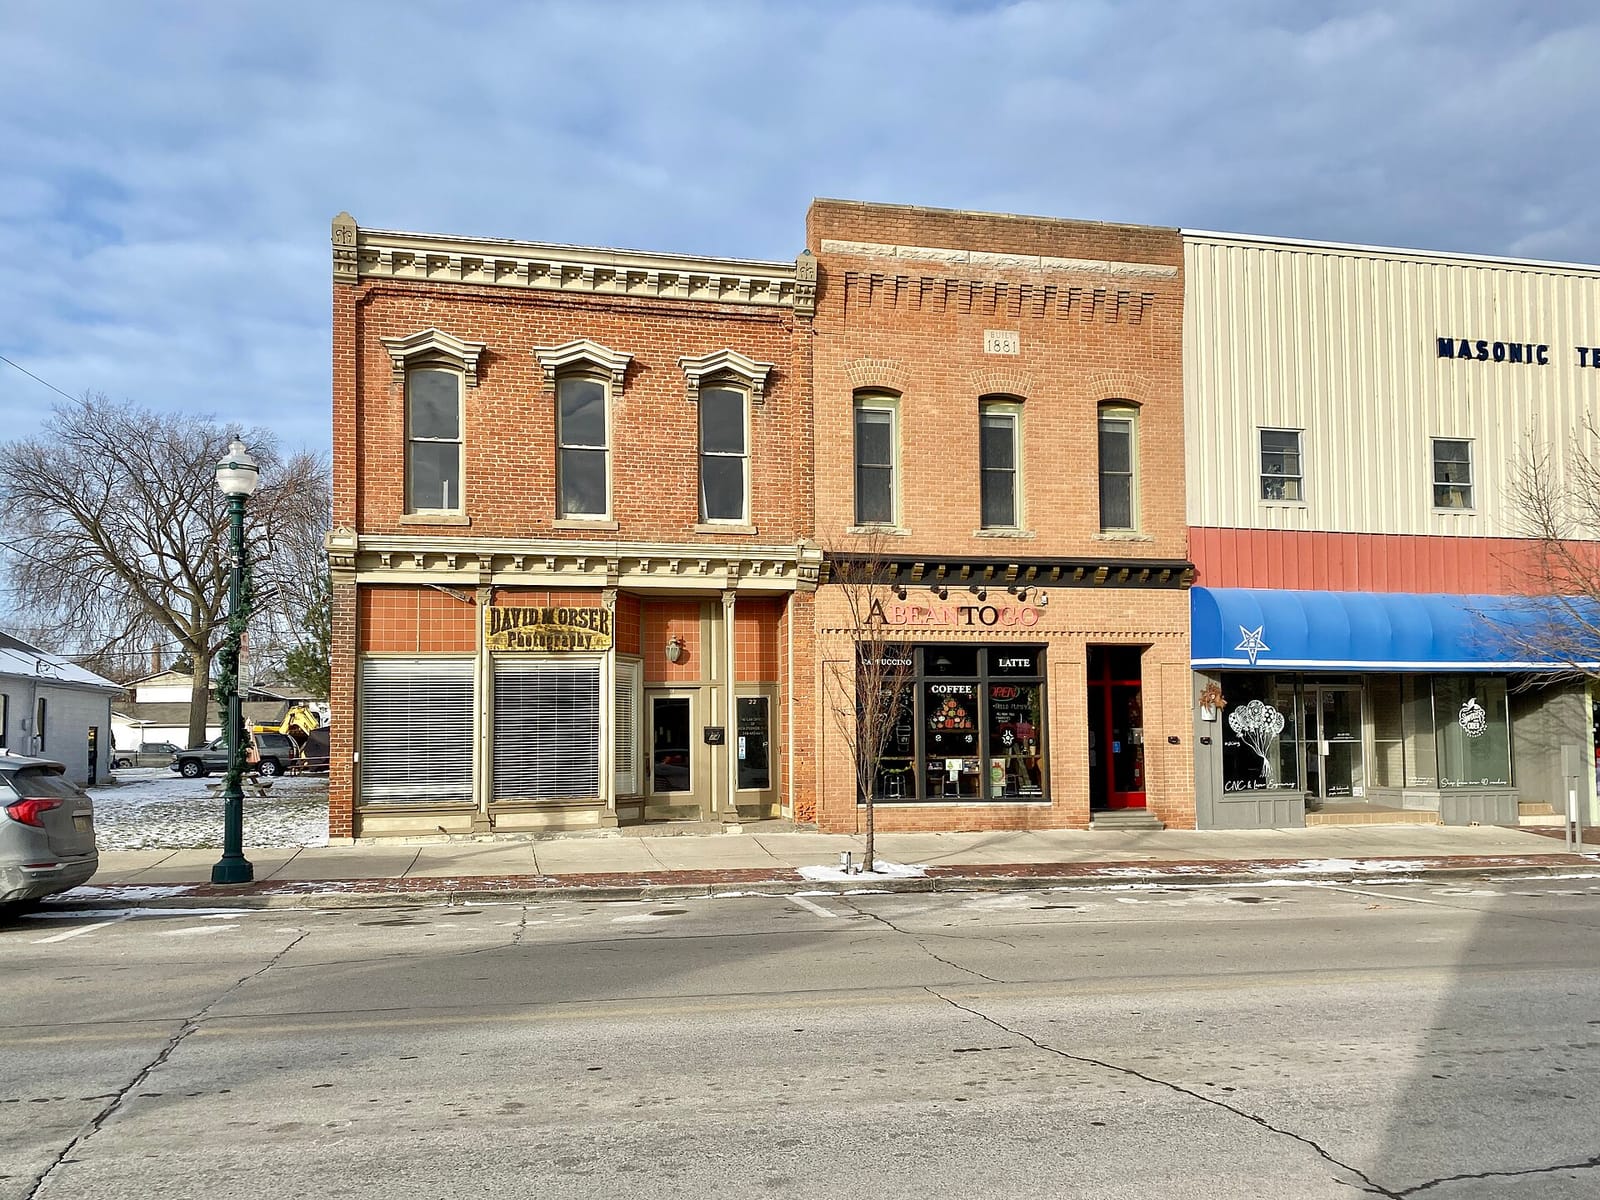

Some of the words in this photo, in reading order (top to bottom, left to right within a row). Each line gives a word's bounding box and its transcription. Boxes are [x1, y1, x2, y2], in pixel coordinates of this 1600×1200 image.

[988, 339, 1016, 352] 1881
[1438, 337, 1549, 365] MASONIC
[490, 607, 539, 636] DAVID
[507, 631, 593, 650] Photography
[861, 658, 912, 666] CAUCCINO
[998, 658, 1031, 668] LATTE
[931, 684, 973, 694] COFFEE
[1224, 780, 1246, 791] CNC
